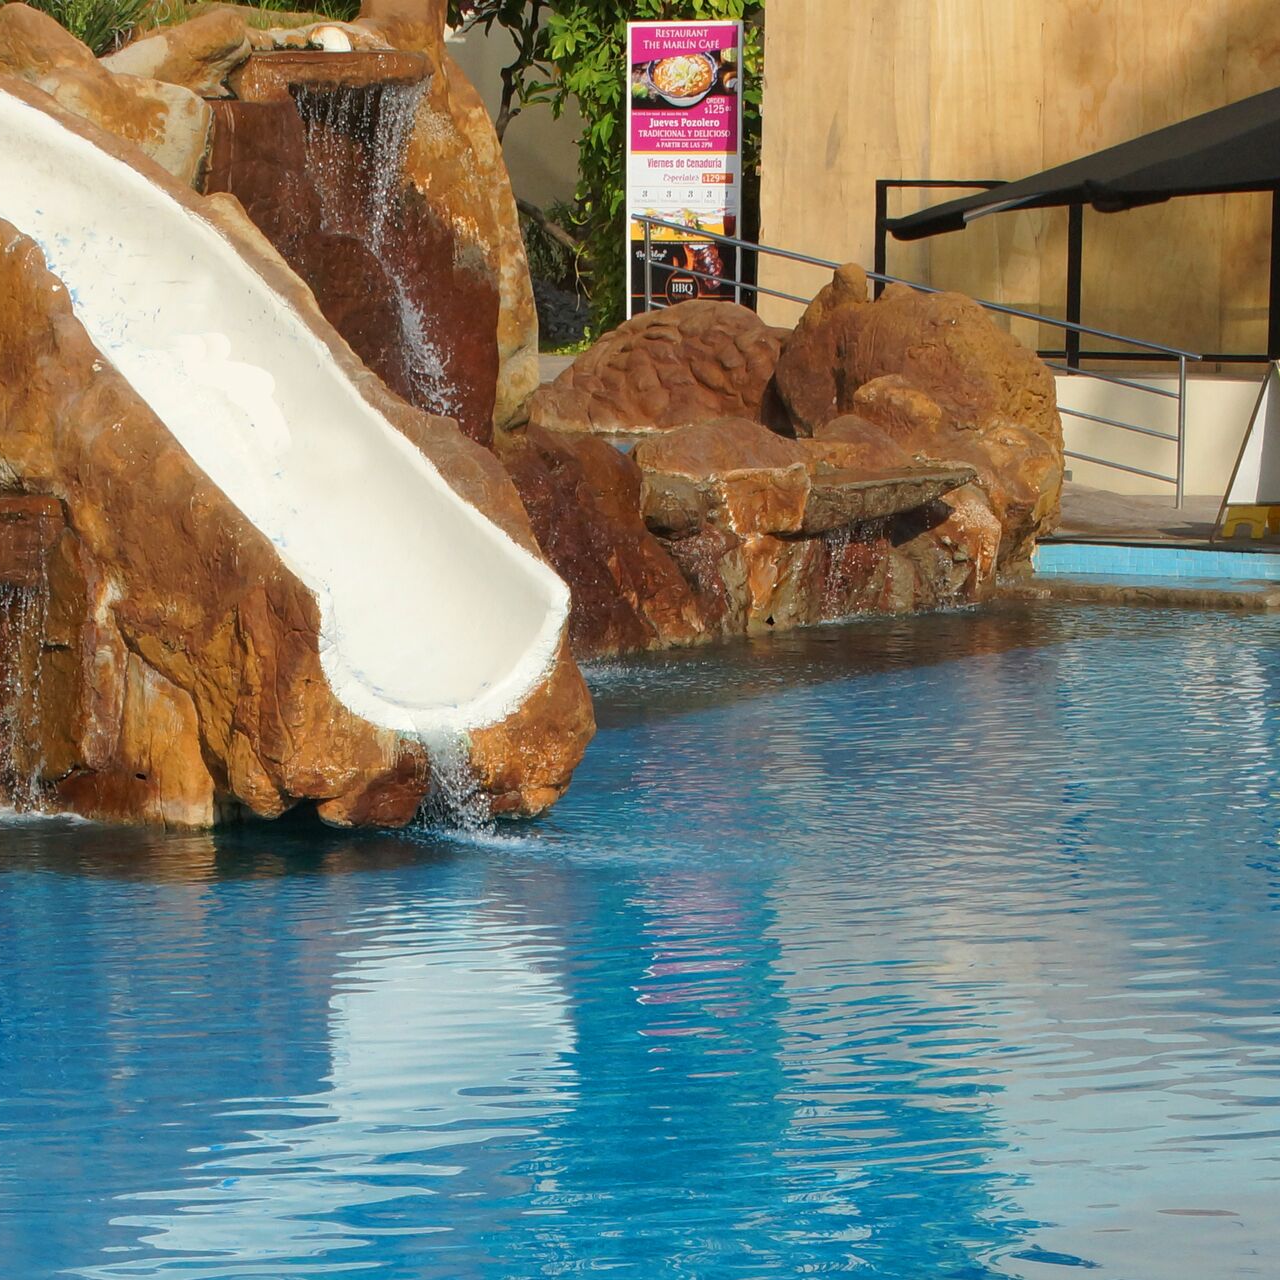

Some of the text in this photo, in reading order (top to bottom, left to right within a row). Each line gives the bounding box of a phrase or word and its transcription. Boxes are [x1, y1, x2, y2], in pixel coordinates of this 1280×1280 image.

[655, 28, 709, 38] RESTAURANT
[643, 39, 719, 49] THE MARLÍN CAFÉ
[649, 118, 720, 128] Jueves Pozolero
[638, 130, 685, 138] TRADICIONAL
[696, 130, 731, 138] DELICIOSO
[647, 158, 722, 168] Viernes de Cenaduría
[671, 283, 693, 295] BBQ
